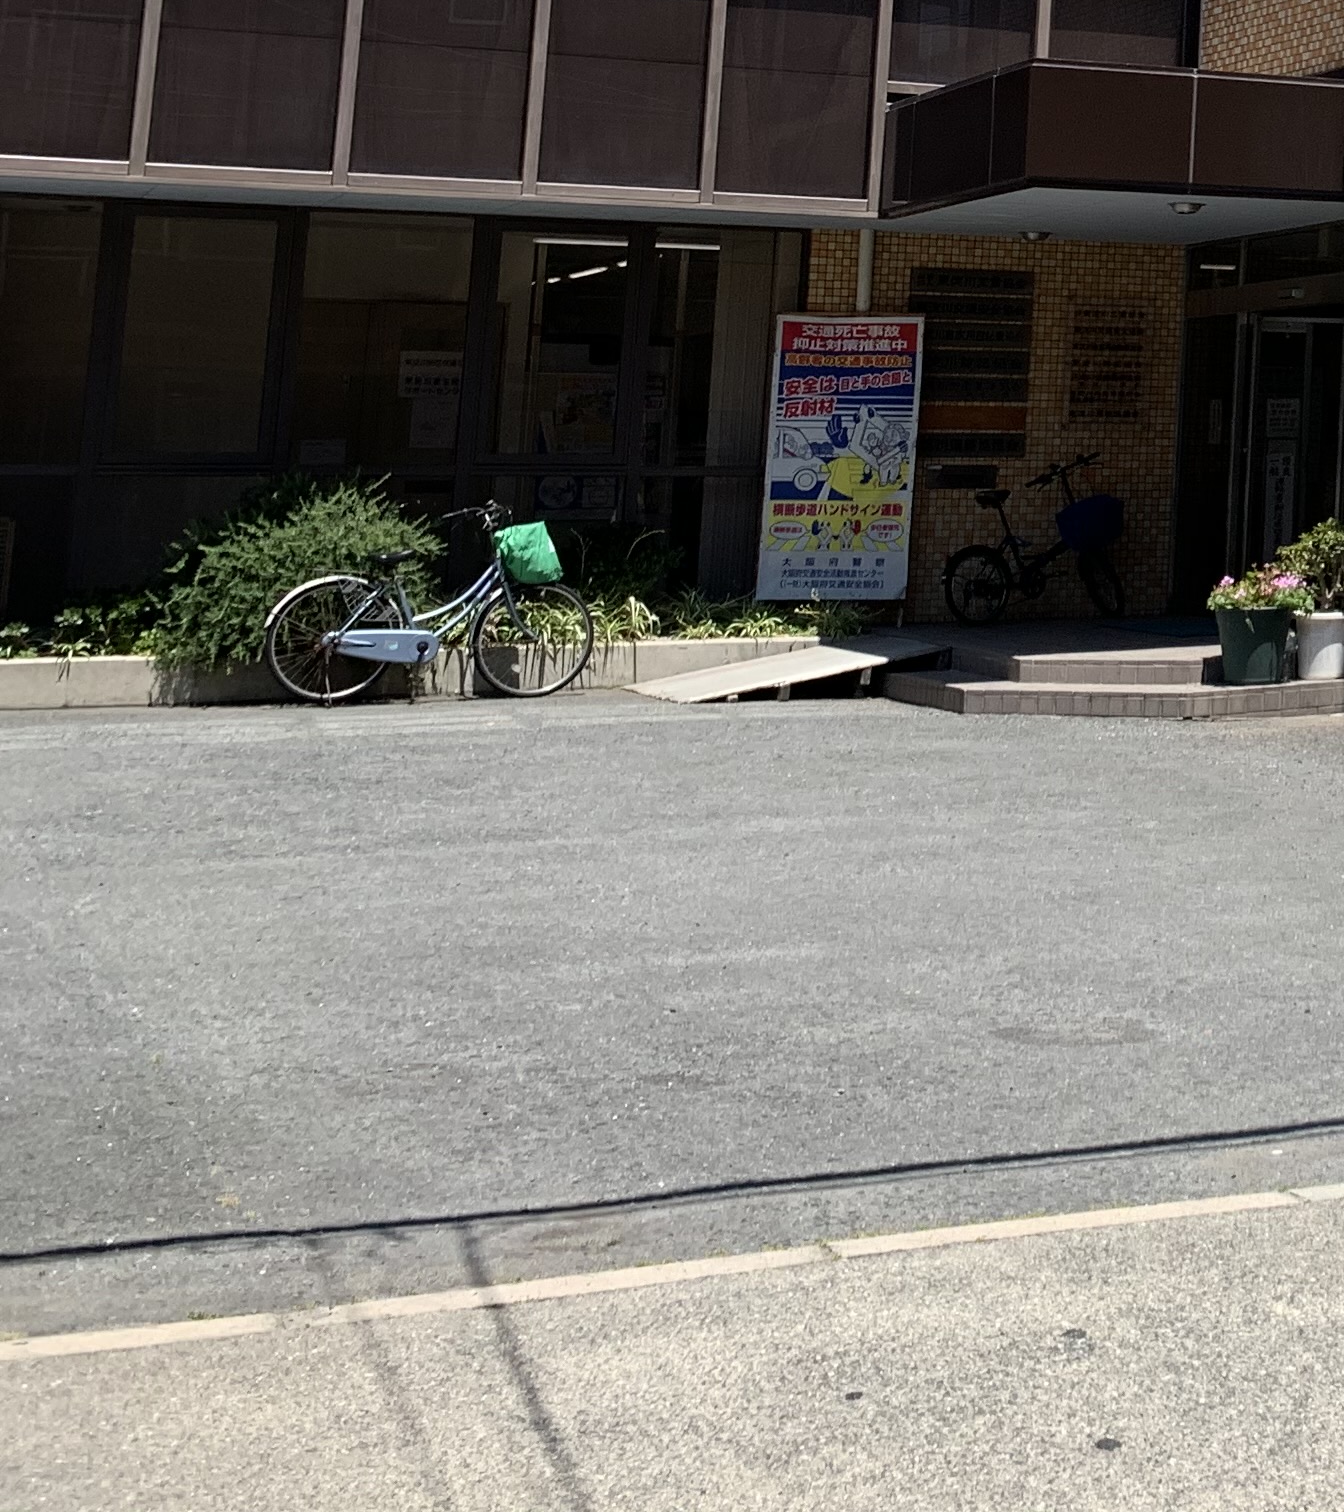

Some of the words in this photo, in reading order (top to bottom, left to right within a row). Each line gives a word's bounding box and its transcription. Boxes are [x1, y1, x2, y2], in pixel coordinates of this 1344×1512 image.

[802, 324, 901, 338] 交通死亡事故
[792, 337, 908, 353] 抑止対策推進中
